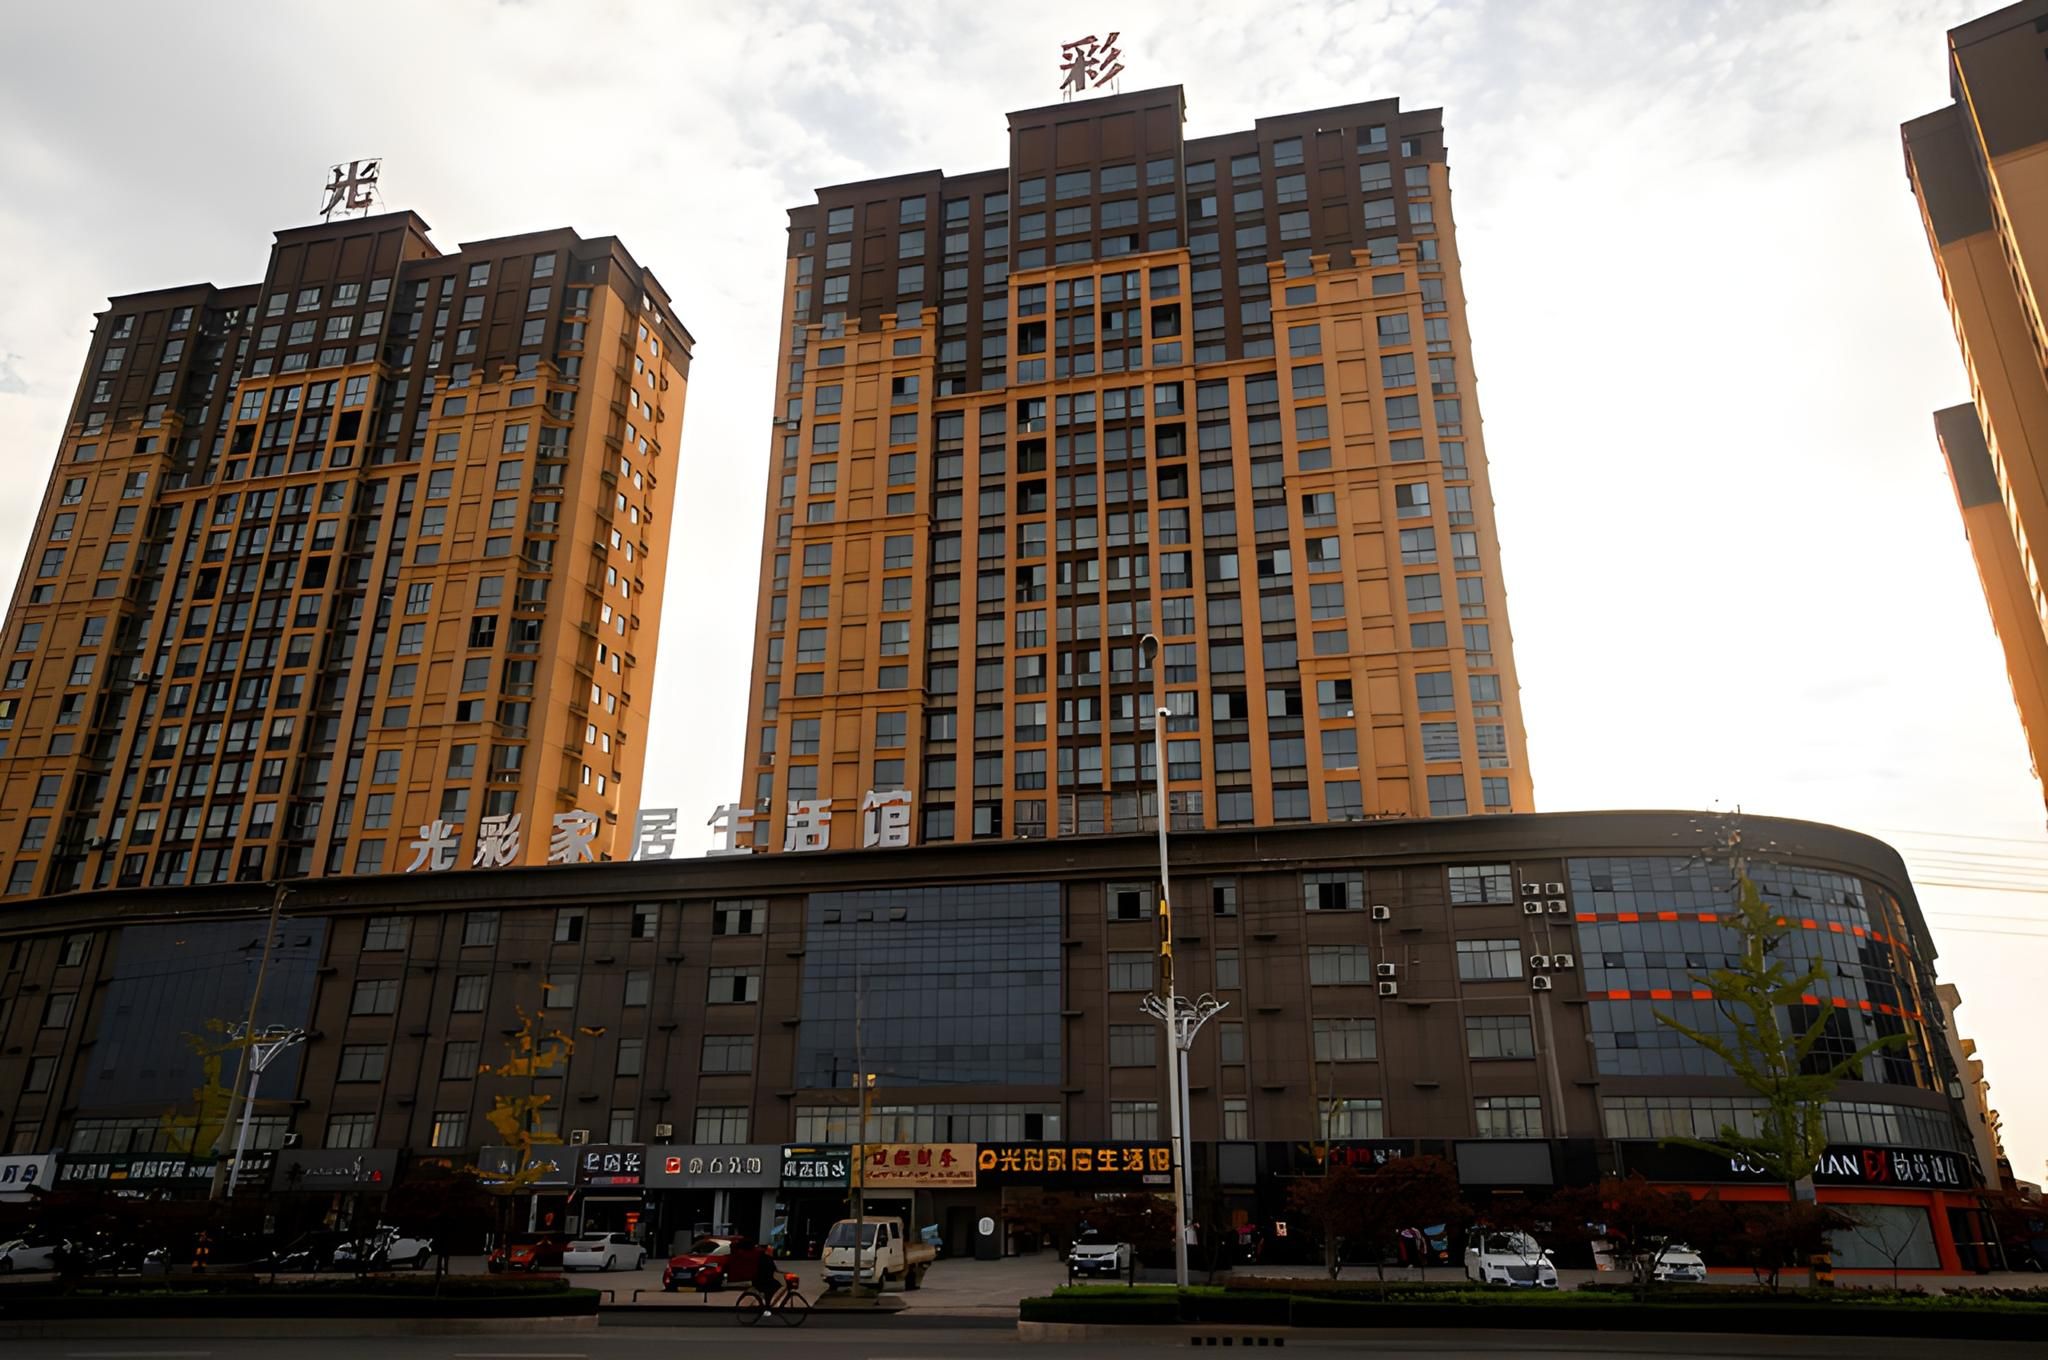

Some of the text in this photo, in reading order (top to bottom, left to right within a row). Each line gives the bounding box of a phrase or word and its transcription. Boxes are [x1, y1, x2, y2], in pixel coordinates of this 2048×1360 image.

[1059, 31, 1125, 92] 彩
[319, 160, 378, 216] 光
[406, 790, 912, 873] 光彩家居生活馆
